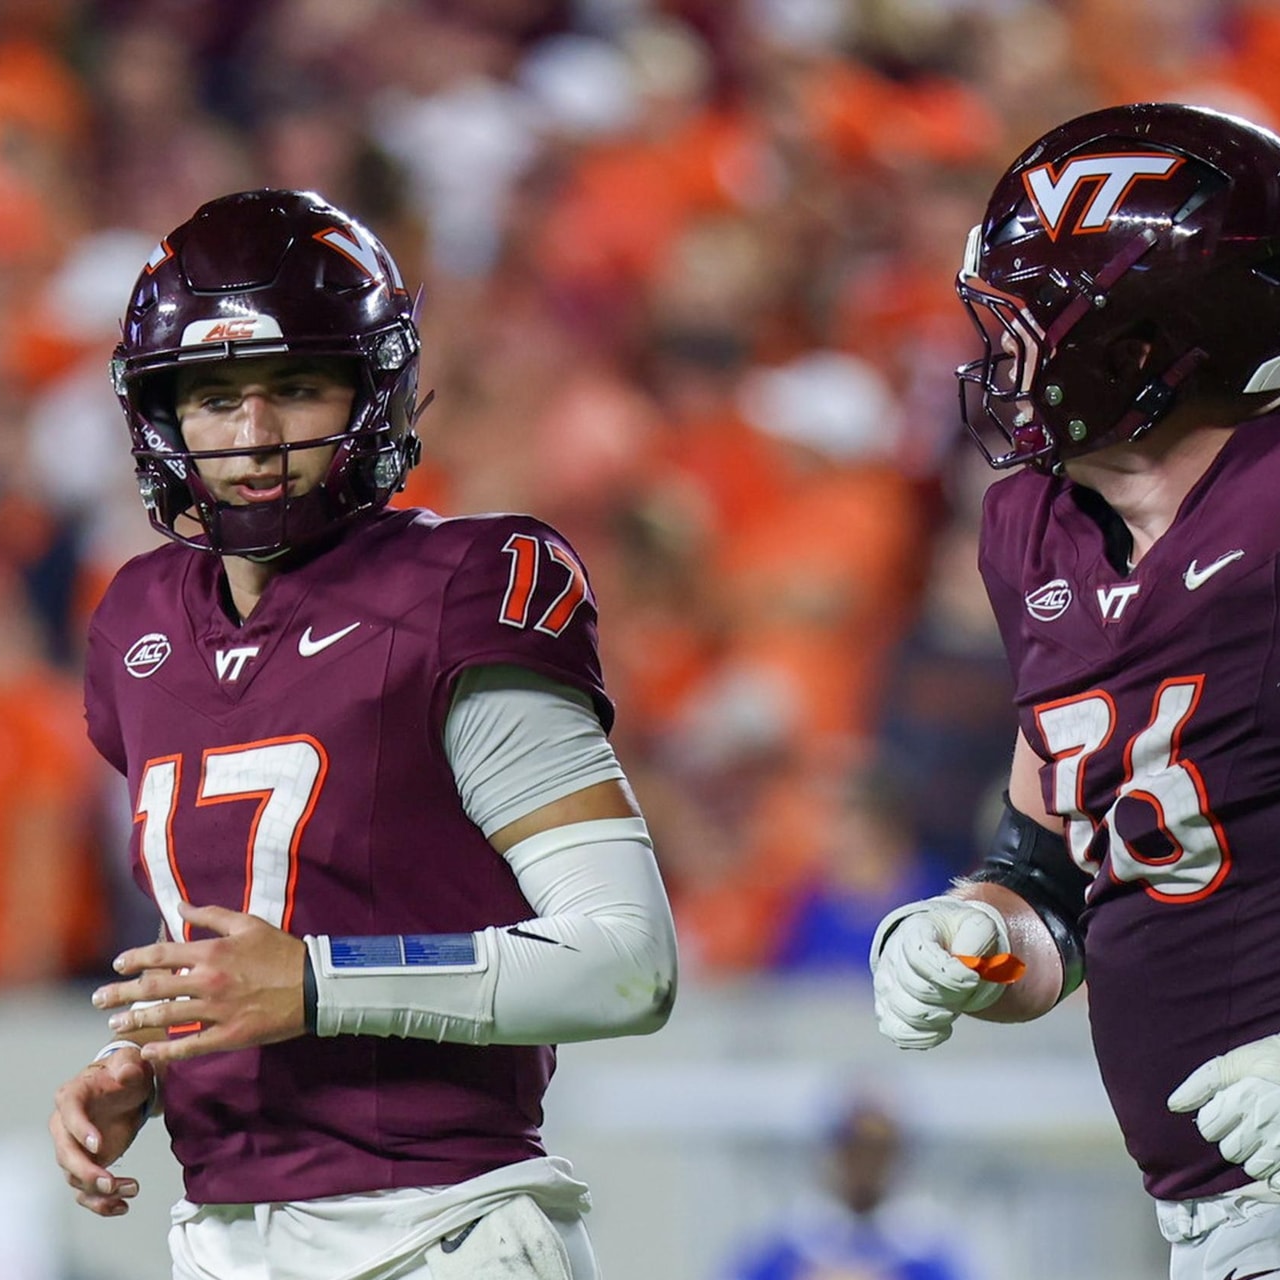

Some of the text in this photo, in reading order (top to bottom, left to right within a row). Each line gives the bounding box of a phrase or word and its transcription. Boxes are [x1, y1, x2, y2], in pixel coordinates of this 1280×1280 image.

[1022, 152, 1186, 242] VT
[141, 424, 187, 479] HOKES
[498, 532, 590, 639] 17
[1096, 584, 1140, 621] VT
[215, 647, 259, 682] VT
[1034, 673, 1232, 904] 76
[133, 733, 329, 1033] 17
